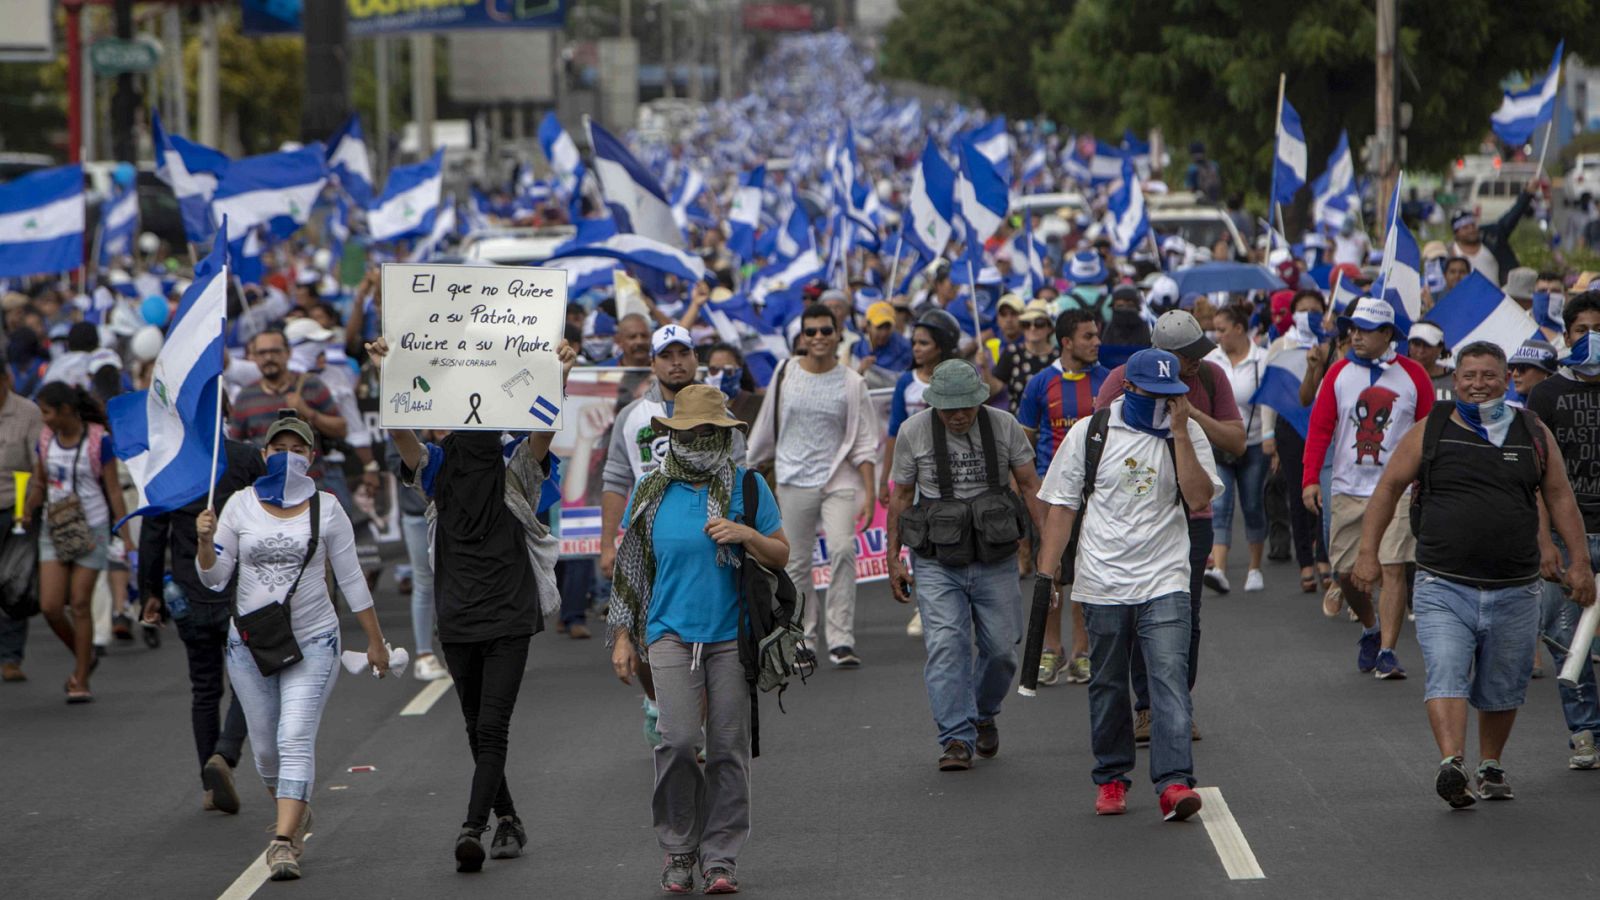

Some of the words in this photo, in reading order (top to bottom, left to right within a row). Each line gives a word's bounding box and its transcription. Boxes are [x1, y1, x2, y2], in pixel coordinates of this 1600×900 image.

[412, 274, 435, 293] El
[447, 283, 473, 301] que
[481, 285, 498, 296] no
[507, 279, 553, 298] Quiere
[429, 313, 439, 323] a
[447, 314, 463, 323] su
[401, 332, 448, 351] Quiere
[457, 341, 466, 351] a
[475, 341, 493, 351] su
[504, 335, 553, 357] Madre.
[1157, 360, 1171, 378] N
[390, 392, 411, 413] 19
[410, 399, 433, 411] Abril
[1556, 392, 1600, 410] ATHL
[1050, 414, 1078, 427] unic
[1574, 410, 1600, 427] DE
[1556, 427, 1600, 443] EAST
[1580, 443, 1600, 460] DI
